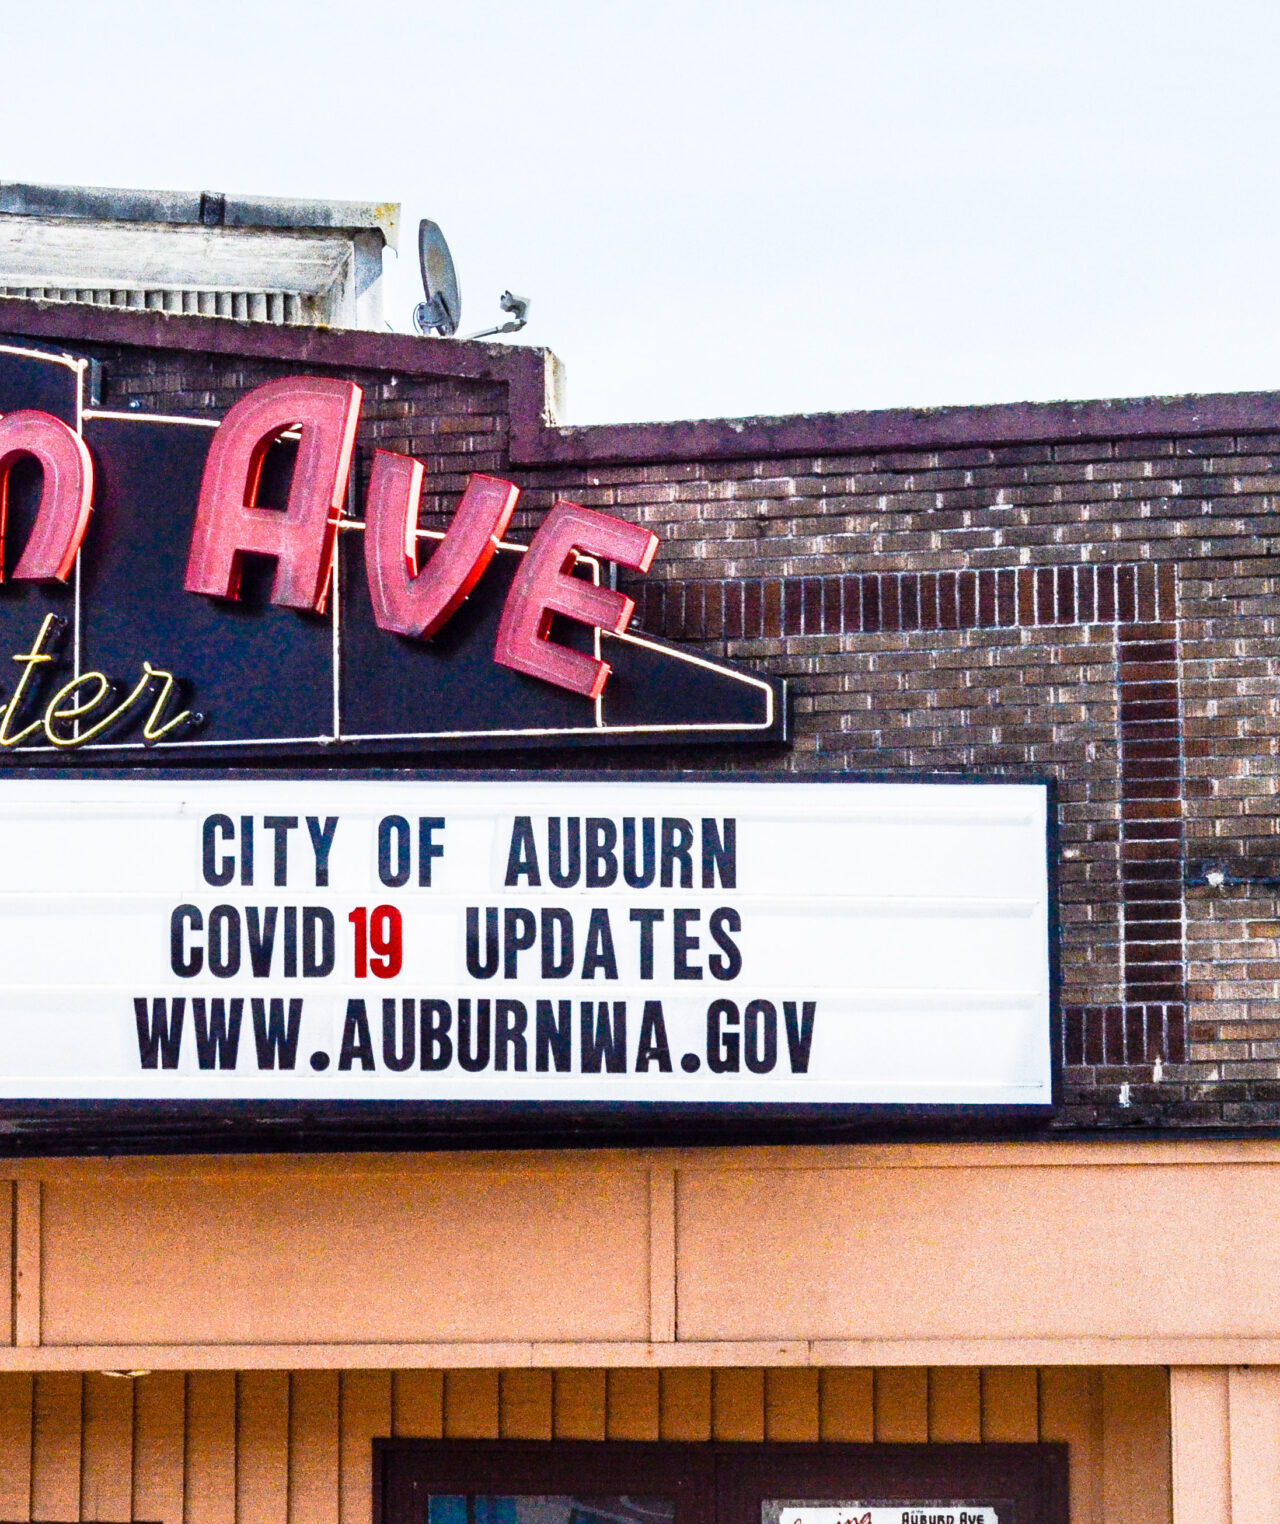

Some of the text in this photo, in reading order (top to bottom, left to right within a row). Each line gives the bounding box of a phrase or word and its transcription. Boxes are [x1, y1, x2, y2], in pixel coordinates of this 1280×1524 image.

[183, 376, 659, 701] AVE
[202, 813, 737, 889] CITY OF AUBURN
[466, 906, 742, 981] UPDATES
[133, 997, 817, 1074] WWW.AUBURNWA.GOV
